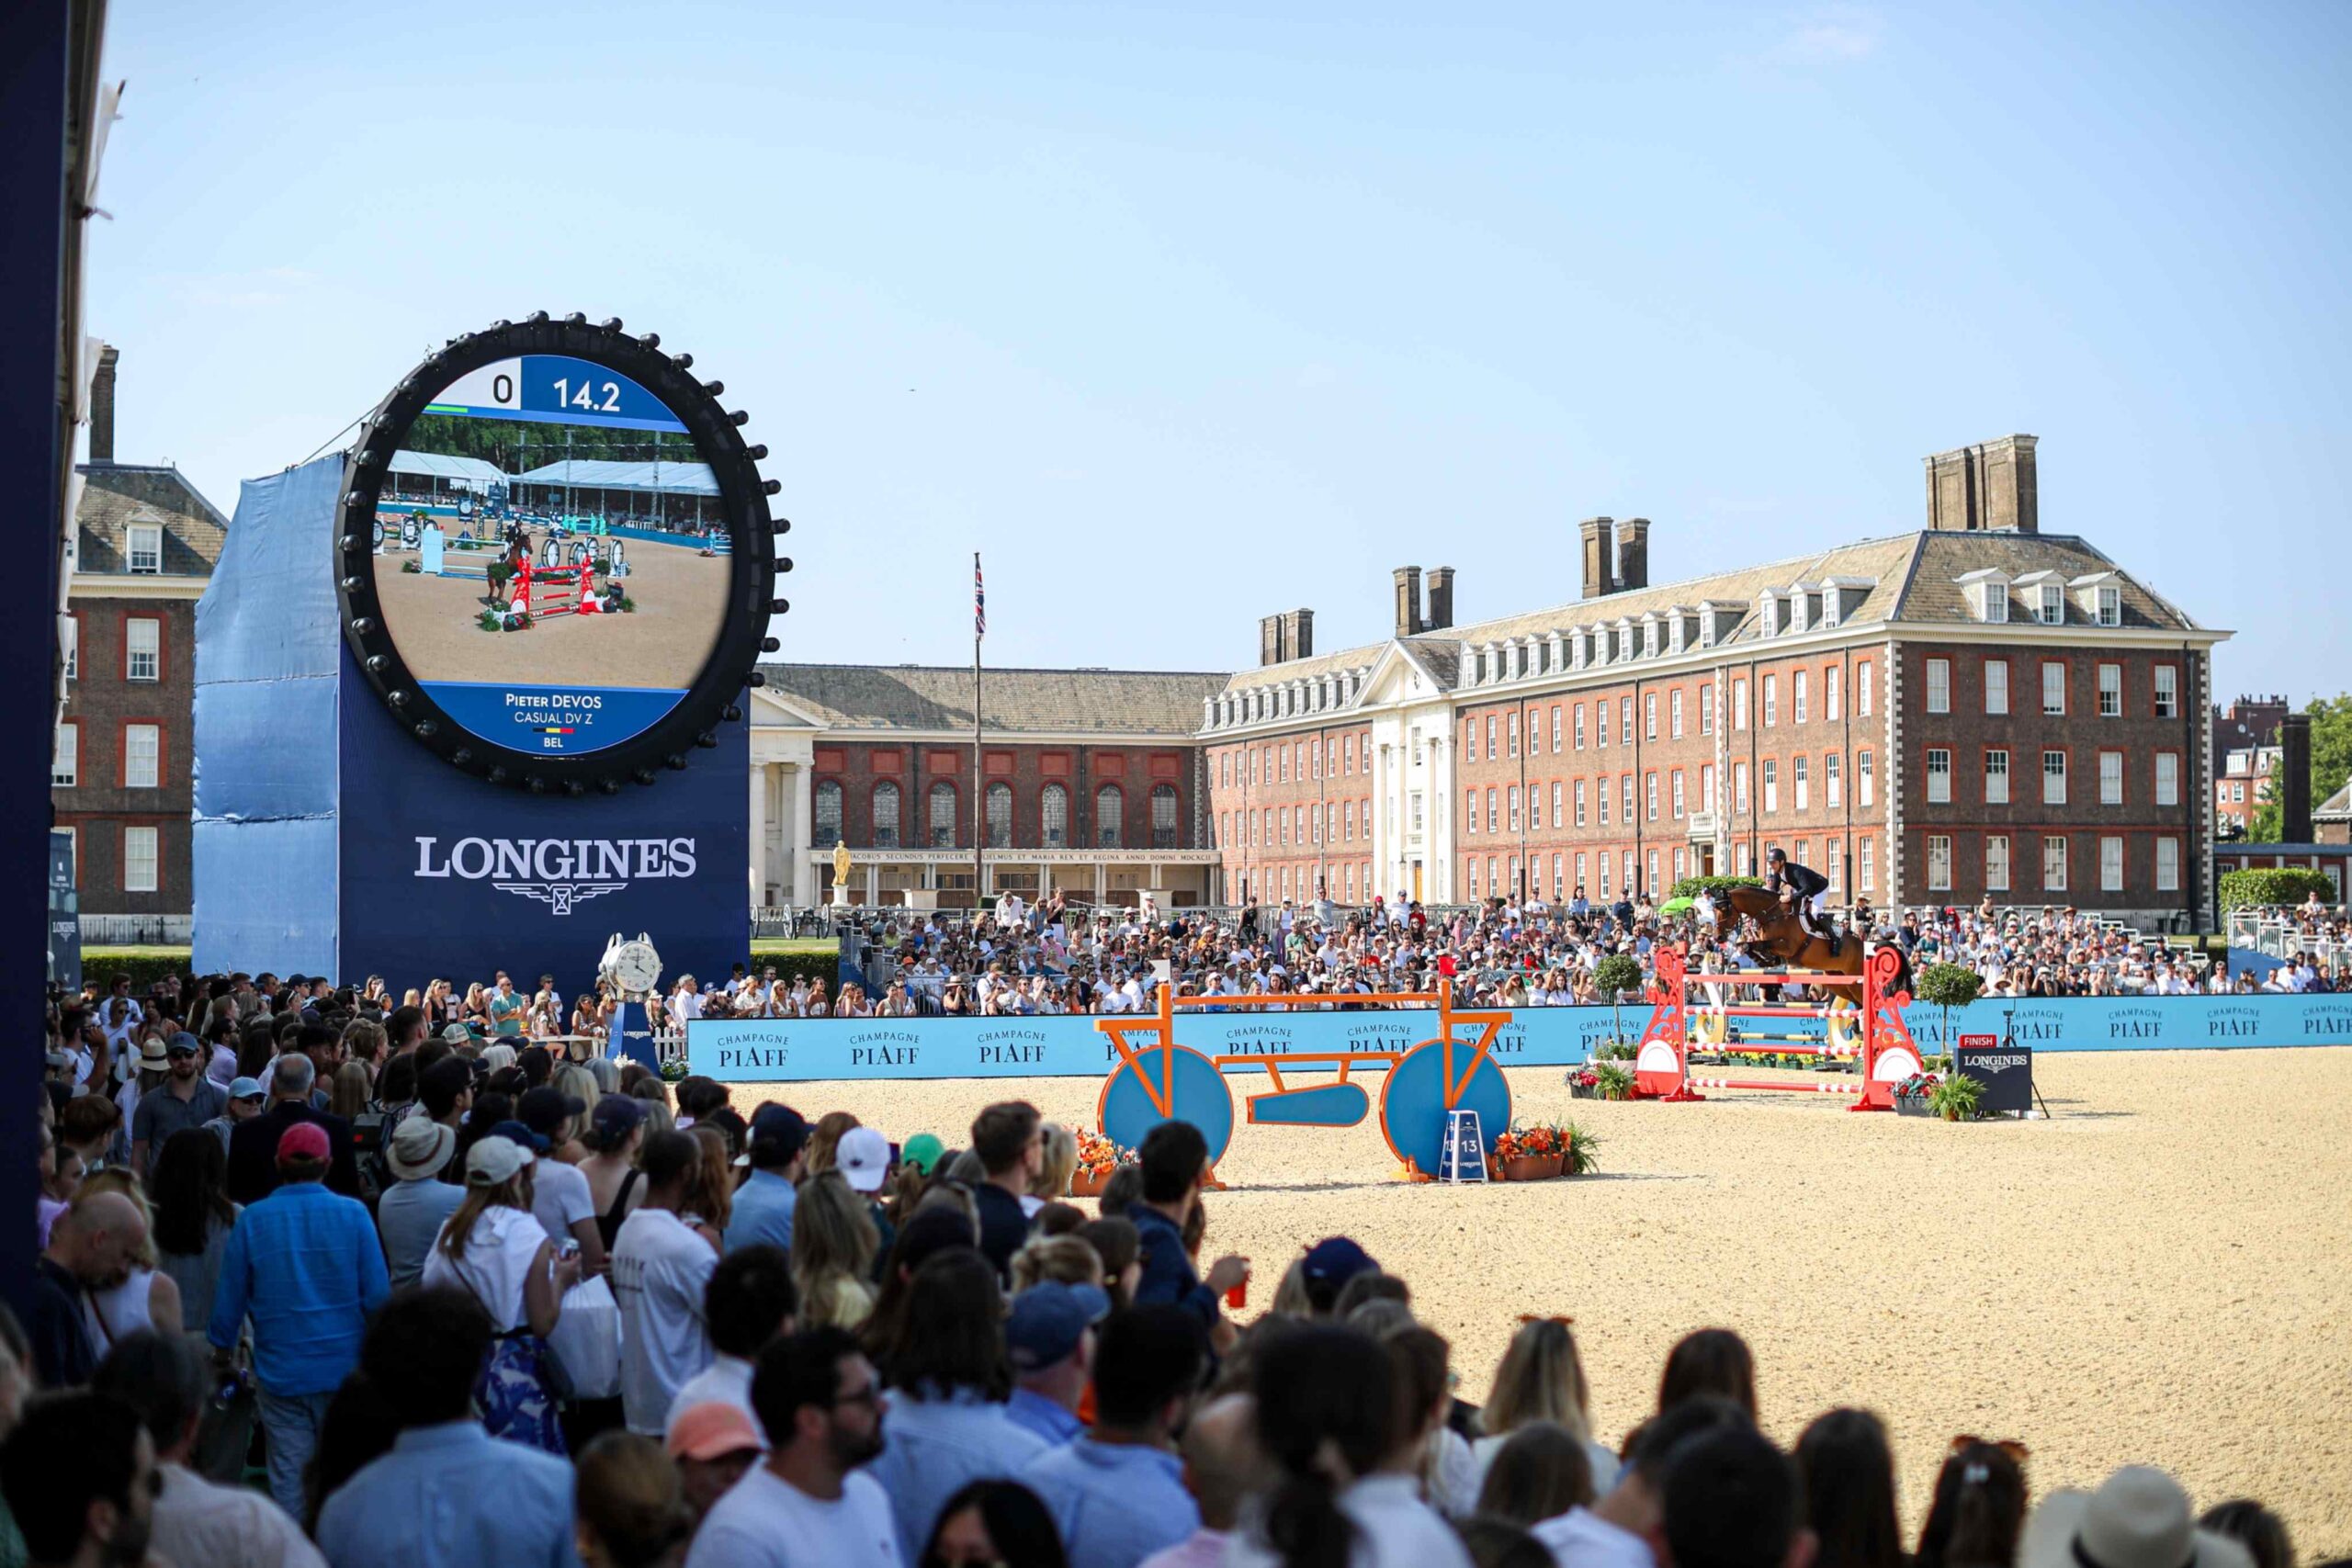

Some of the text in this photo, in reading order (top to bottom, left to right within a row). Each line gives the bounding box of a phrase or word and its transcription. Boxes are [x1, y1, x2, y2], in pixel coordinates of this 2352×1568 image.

[493, 374, 620, 412] 0 14.2
[552, 695, 602, 709] DEVOS
[514, 712, 593, 725] CASUAL DV Z
[544, 738, 563, 748] BEL
[414, 837, 696, 880] LONGINES
[886, 852, 923, 861] SECUNDUS
[928, 852, 967, 861] PERFECERE
[1017, 852, 1026, 861] ET
[1032, 852, 1055, 861] MARIA
[1059, 852, 1074, 861] REX
[1080, 852, 1088, 861] ET
[1093, 852, 1120, 861] REGINA
[1125, 852, 1146, 861] ANNO
[1149, 852, 1176, 861] DOMINI
[1180, 852, 1211, 861] MDCXCII
[1905, 1012, 1962, 1023] CHAMPANE
[2109, 1008, 2162, 1020] CHAMPAGNE
[2207, 1007, 2260, 1018] CHAMPAGNE
[1227, 1026, 1292, 1038] CHAMPAGNE
[1347, 1024, 1411, 1036] CHAMPAGNE
[2010, 1021, 2064, 1039] PIAFF
[2110, 1020, 2162, 1037] PIAFF
[2209, 1018, 2259, 1035] PIAFF
[718, 1033, 789, 1046] CHAMPAGNE
[849, 1032, 920, 1044] CHAMPAGNE
[978, 1030, 1046, 1043] CHAMPAGNE
[1964, 1036, 1993, 1045] FINISH
[1228, 1039, 1292, 1055] PIAFF
[1350, 1035, 1411, 1053] PIAFF
[718, 1046, 788, 1066] PIAFF
[852, 1044, 920, 1065] PIAFF
[979, 1043, 1046, 1063] PIAFF
[1964, 1055, 2028, 1066] LONGINES
[1462, 1140, 1477, 1153] 13
